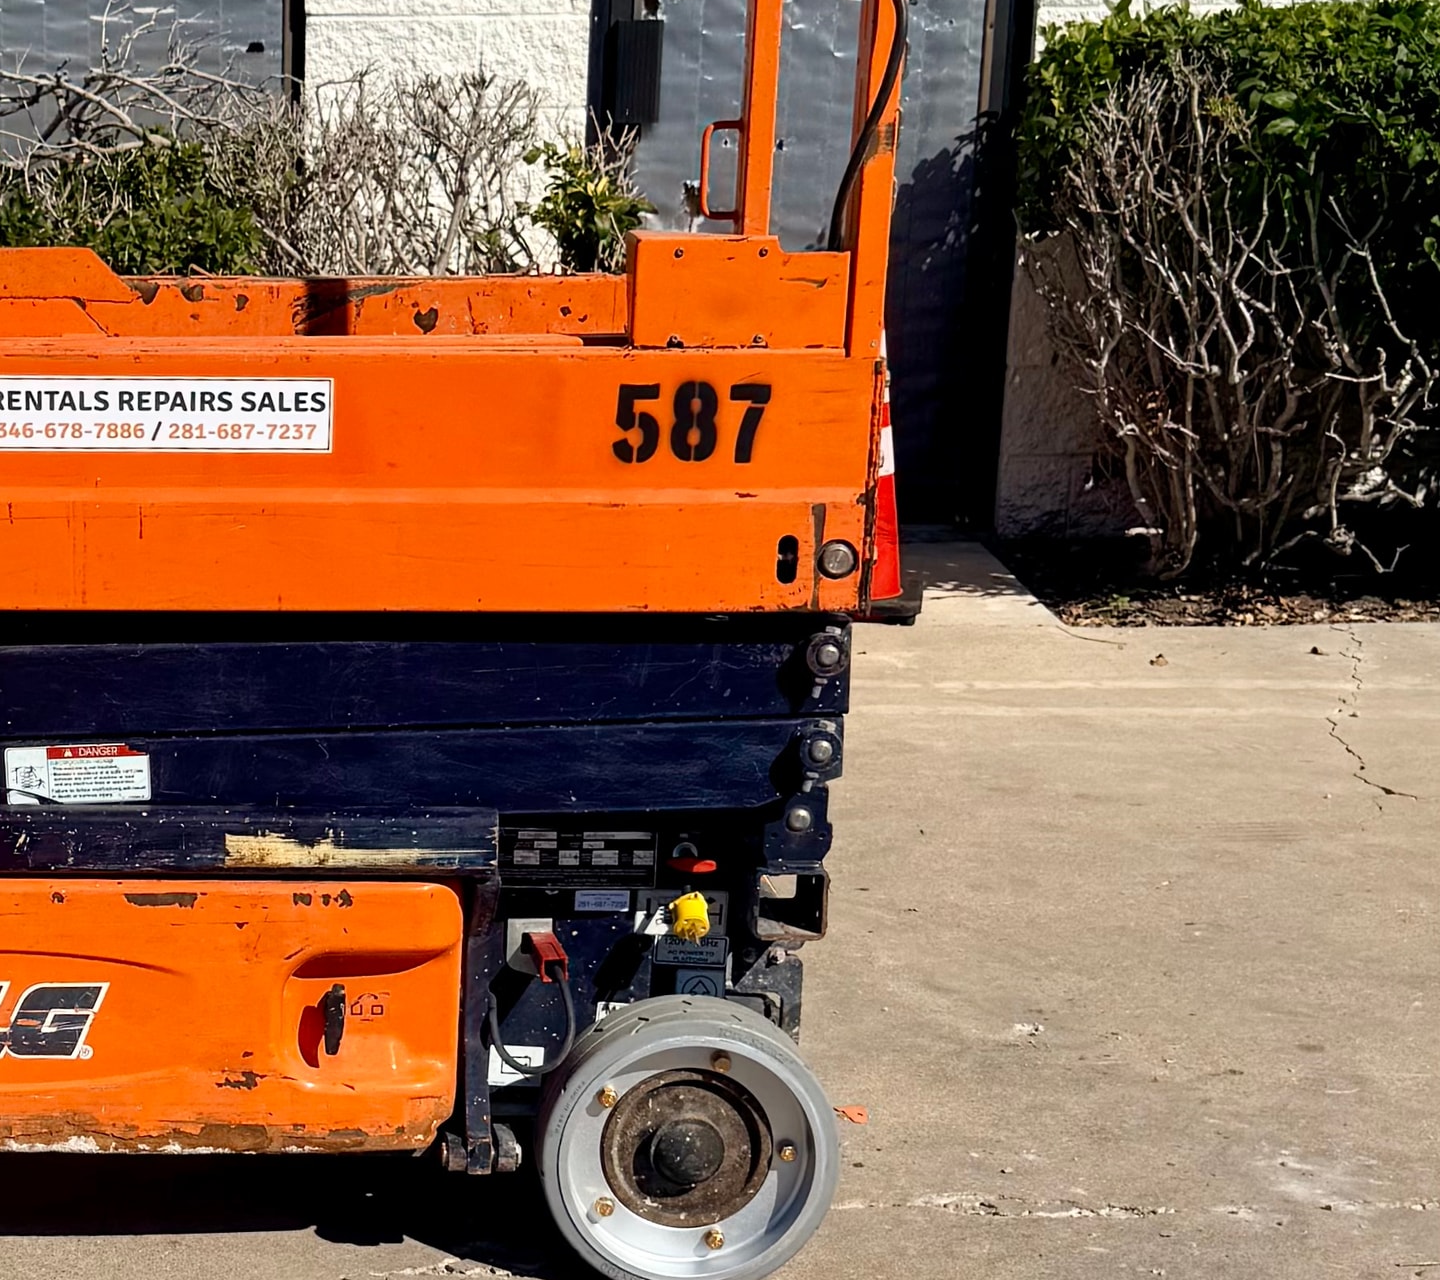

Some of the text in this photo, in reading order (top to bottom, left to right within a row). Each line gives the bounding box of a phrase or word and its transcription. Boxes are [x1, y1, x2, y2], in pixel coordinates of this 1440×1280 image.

[118, 390, 234, 412] REPAIRS
[240, 391, 327, 413] SALES
[151, 421, 163, 442] /
[168, 423, 318, 440] 281-687-7237
[611, 380, 773, 464] 587
[78, 746, 118, 757] DANGER
